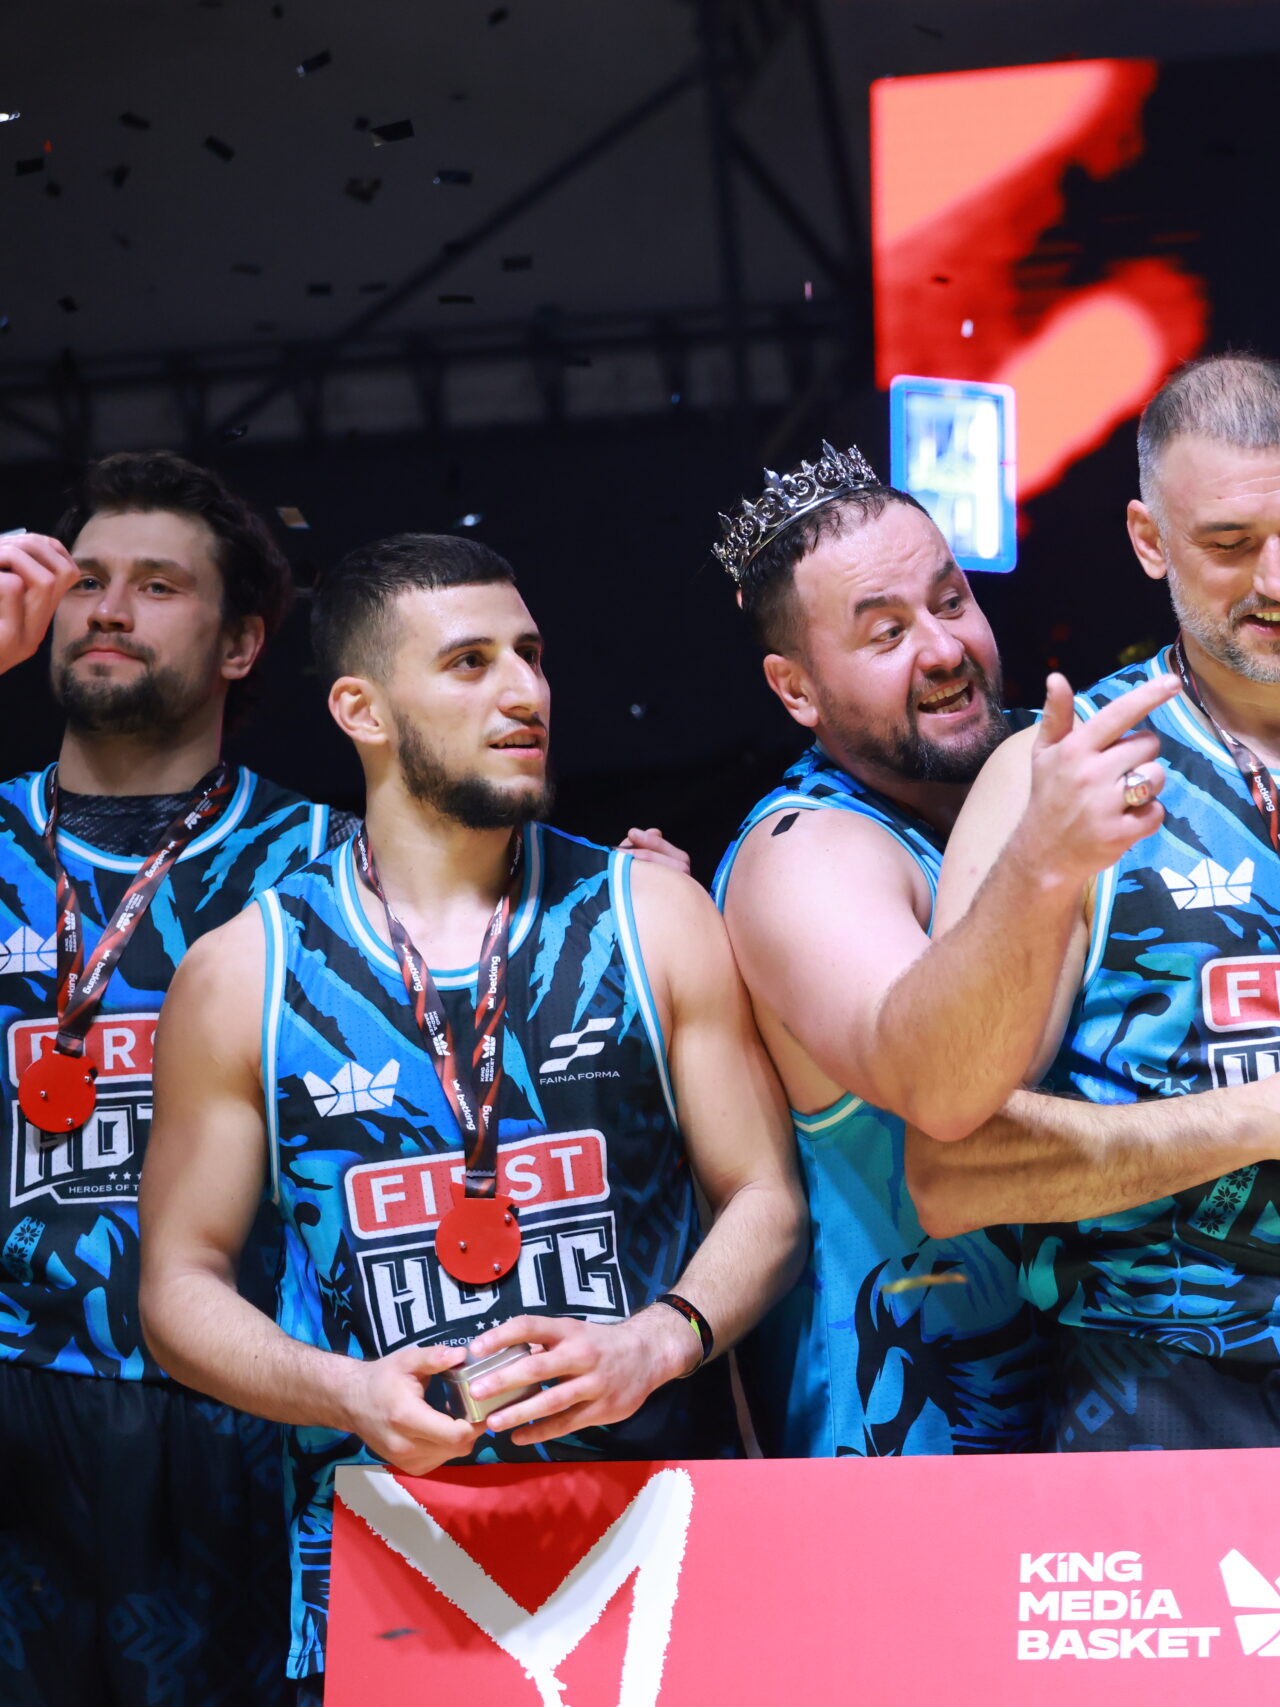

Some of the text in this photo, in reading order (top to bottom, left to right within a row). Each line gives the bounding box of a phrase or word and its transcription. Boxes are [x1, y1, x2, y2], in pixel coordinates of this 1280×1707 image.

[1254, 775, 1276, 812] betking
[82, 961, 107, 995] betking
[405, 956, 424, 992] betking
[488, 956, 501, 993] betking
[540, 1070, 621, 1086] FAINA FORMA
[457, 1094, 476, 1131] betking
[69, 1185, 112, 1194] HEROES
[115, 1184, 130, 1192] OF
[370, 1145, 583, 1223] FIST
[1017, 1627, 1221, 1660] BASKET
